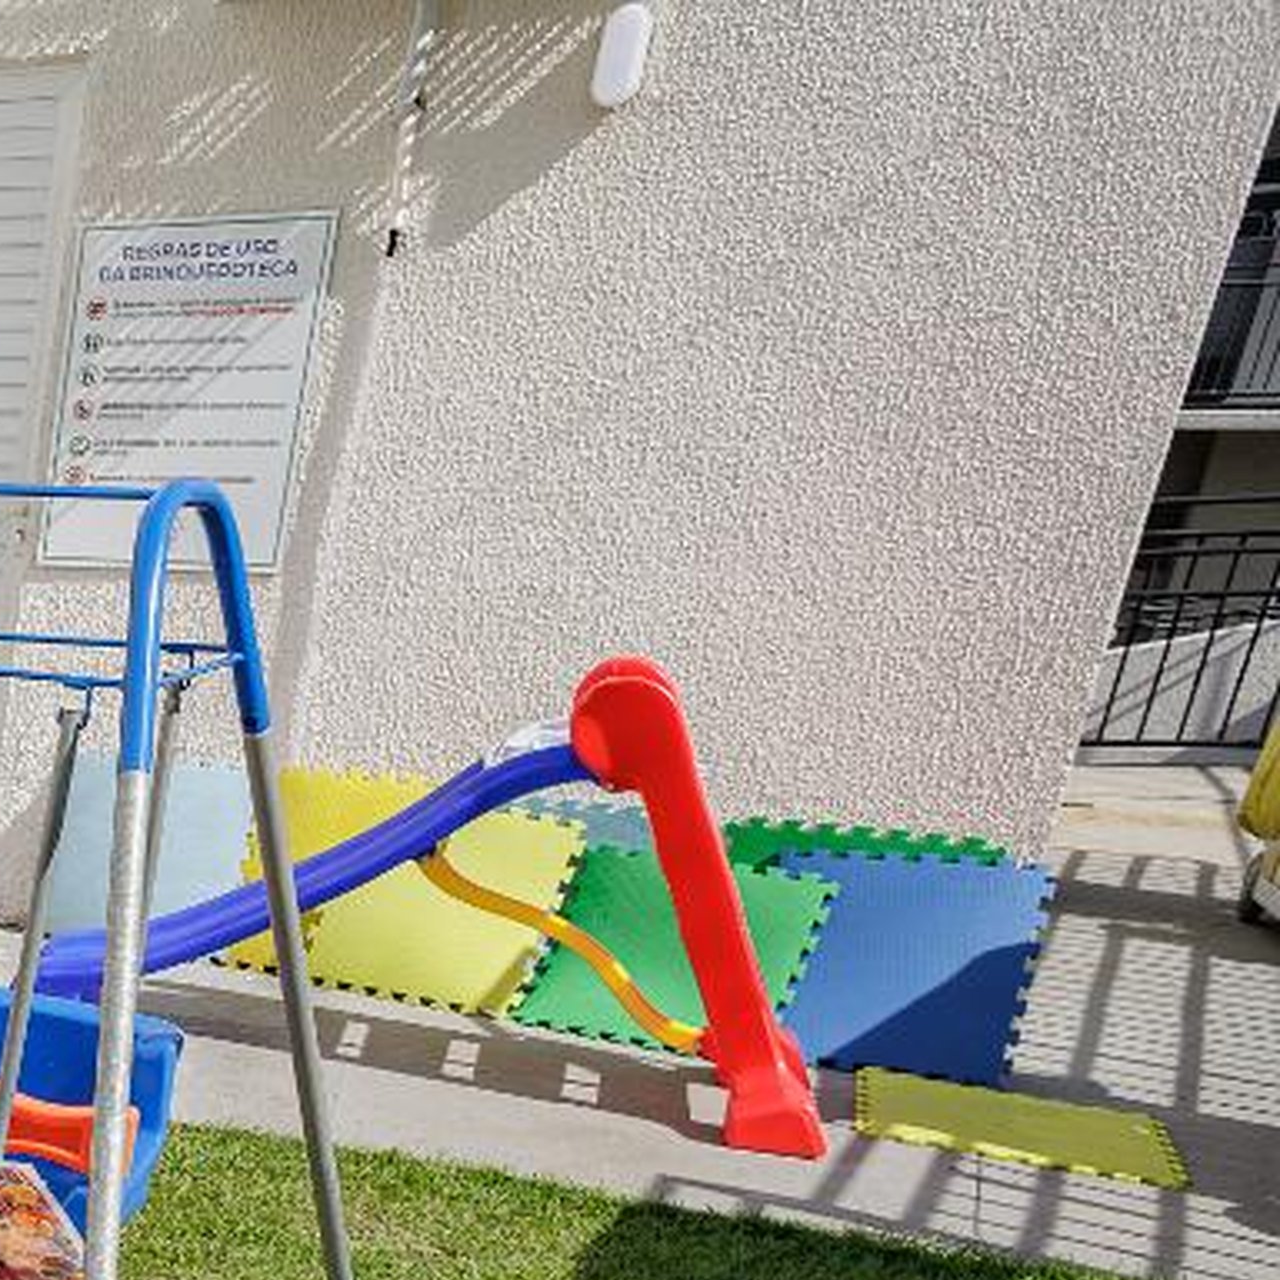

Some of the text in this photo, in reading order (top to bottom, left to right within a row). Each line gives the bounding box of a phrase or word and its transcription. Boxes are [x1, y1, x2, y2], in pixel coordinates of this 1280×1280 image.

[123, 238, 279, 260] REGRAS DE USO
[129, 260, 297, 281] BRINQUEDOTECA
